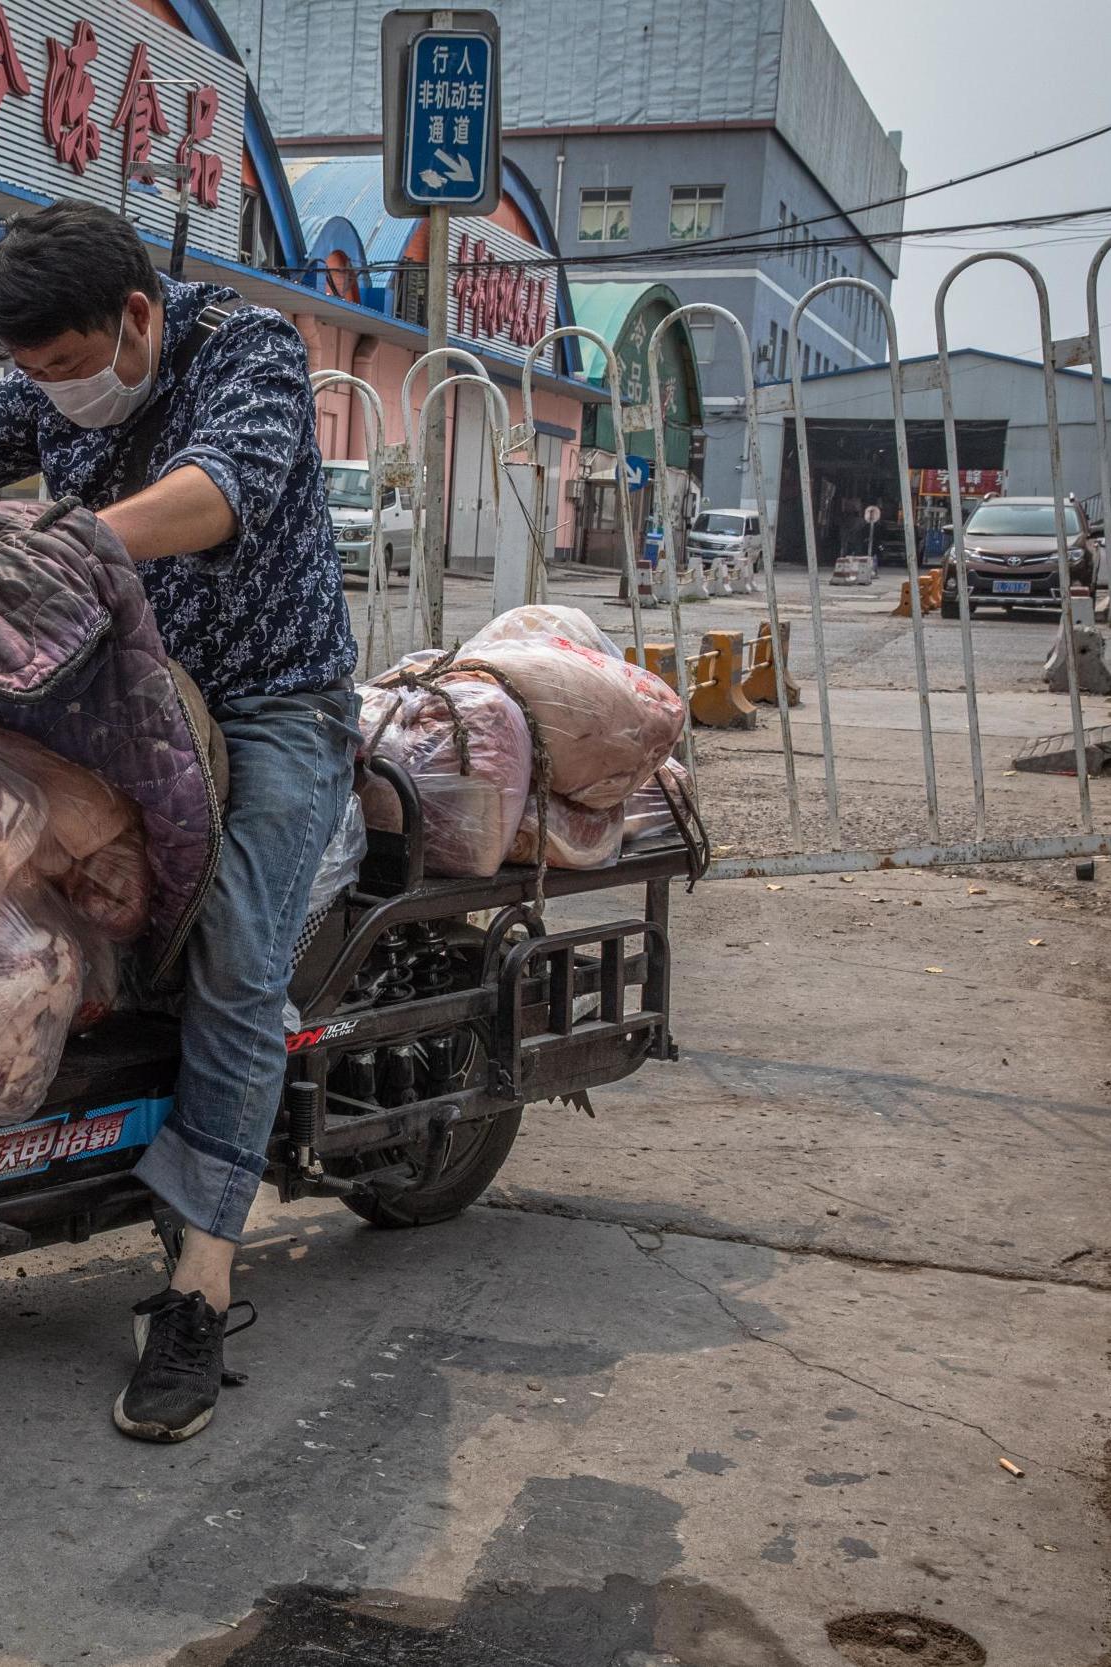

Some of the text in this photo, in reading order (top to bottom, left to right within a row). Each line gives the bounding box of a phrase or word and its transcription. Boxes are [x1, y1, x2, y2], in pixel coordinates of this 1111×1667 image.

[432, 45, 473, 75] 行人
[418, 80, 484, 111] 非机动车
[428, 115, 471, 145] 通道
